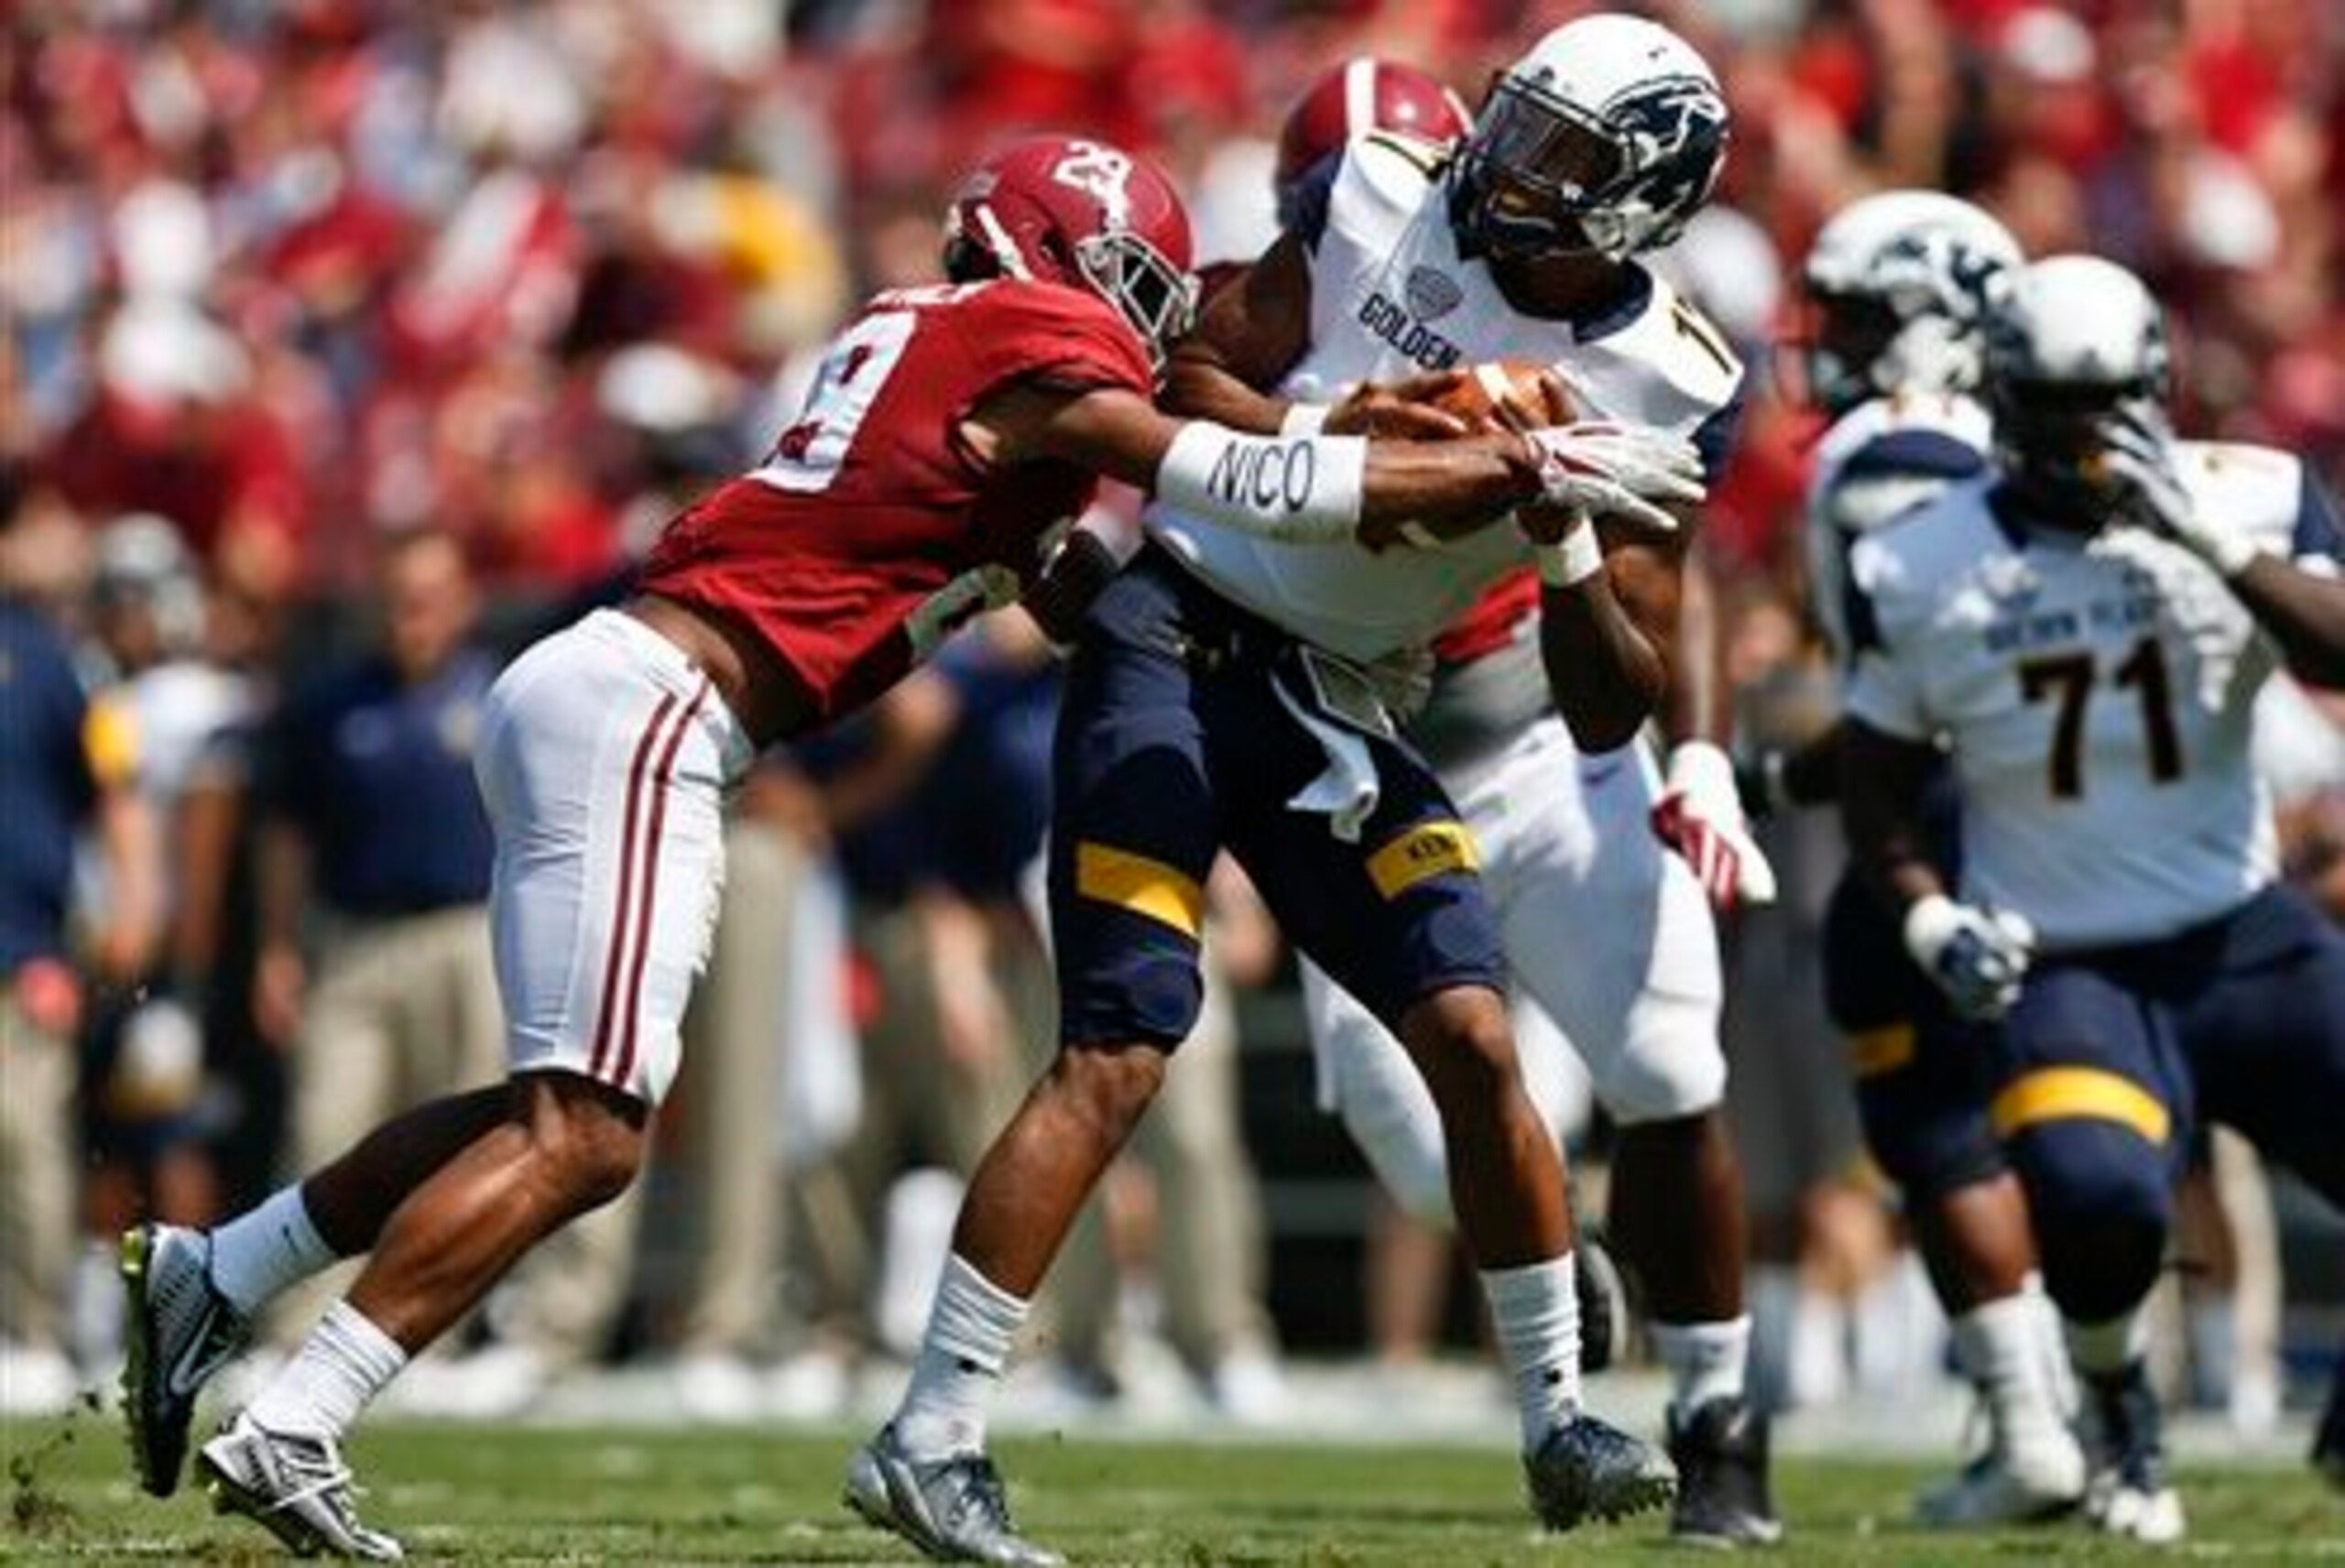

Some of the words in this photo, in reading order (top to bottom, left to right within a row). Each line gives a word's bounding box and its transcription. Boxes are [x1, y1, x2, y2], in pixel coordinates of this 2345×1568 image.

[1053, 140, 1132, 201] 29
[1358, 291, 1462, 370] GOLDEN
[1206, 440, 1314, 512] NICO
[2015, 635, 2185, 800] 71
